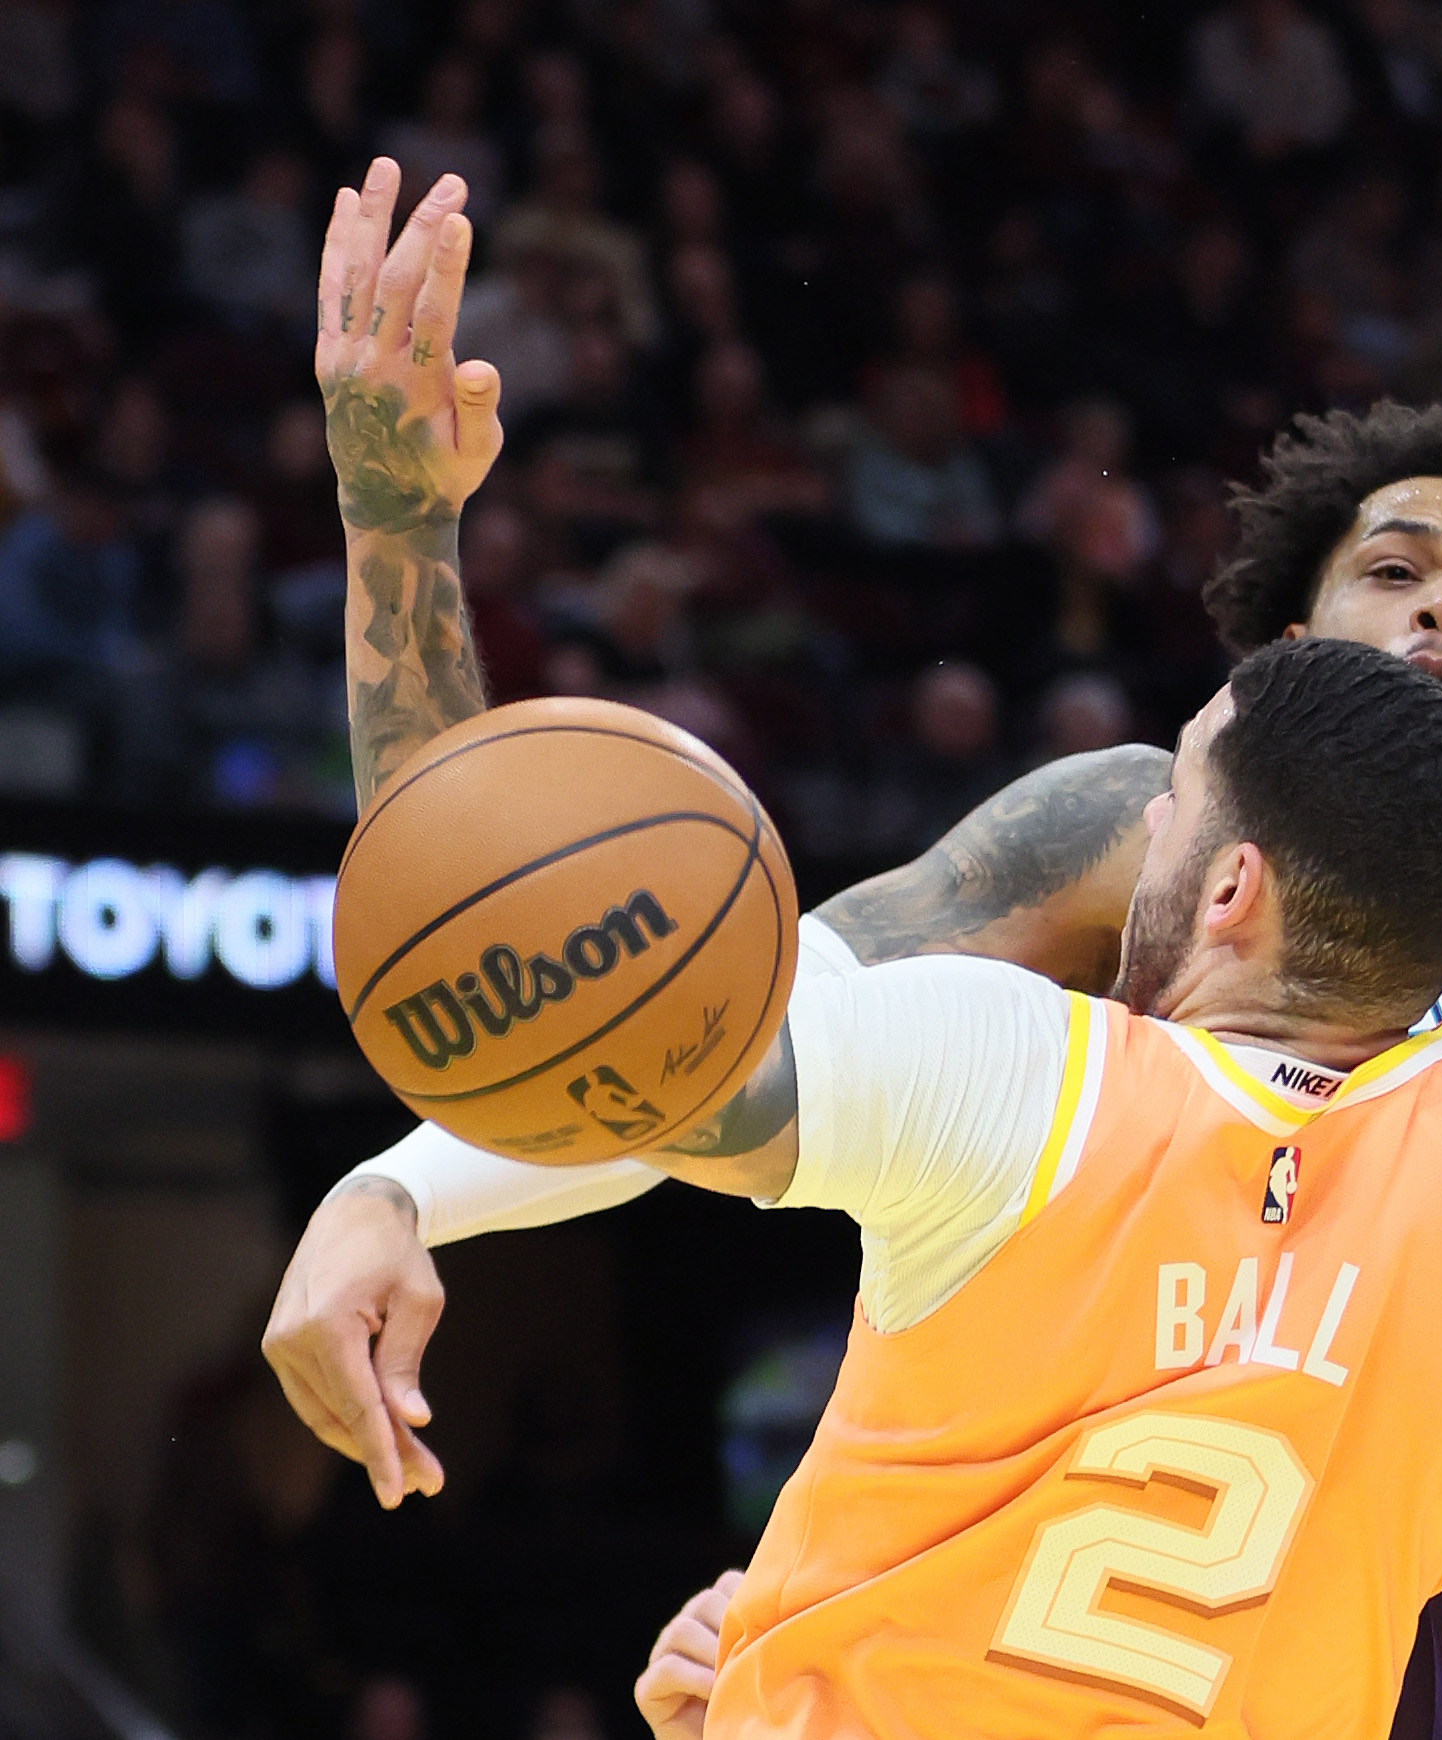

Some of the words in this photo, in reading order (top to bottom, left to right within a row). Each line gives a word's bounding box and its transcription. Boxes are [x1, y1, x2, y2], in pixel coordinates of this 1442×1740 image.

[0, 852, 338, 990] TOYOT
[382, 889, 679, 1071] Wilson
[1155, 1252, 1361, 1387] BALL
[985, 1410, 1316, 1729] 2
